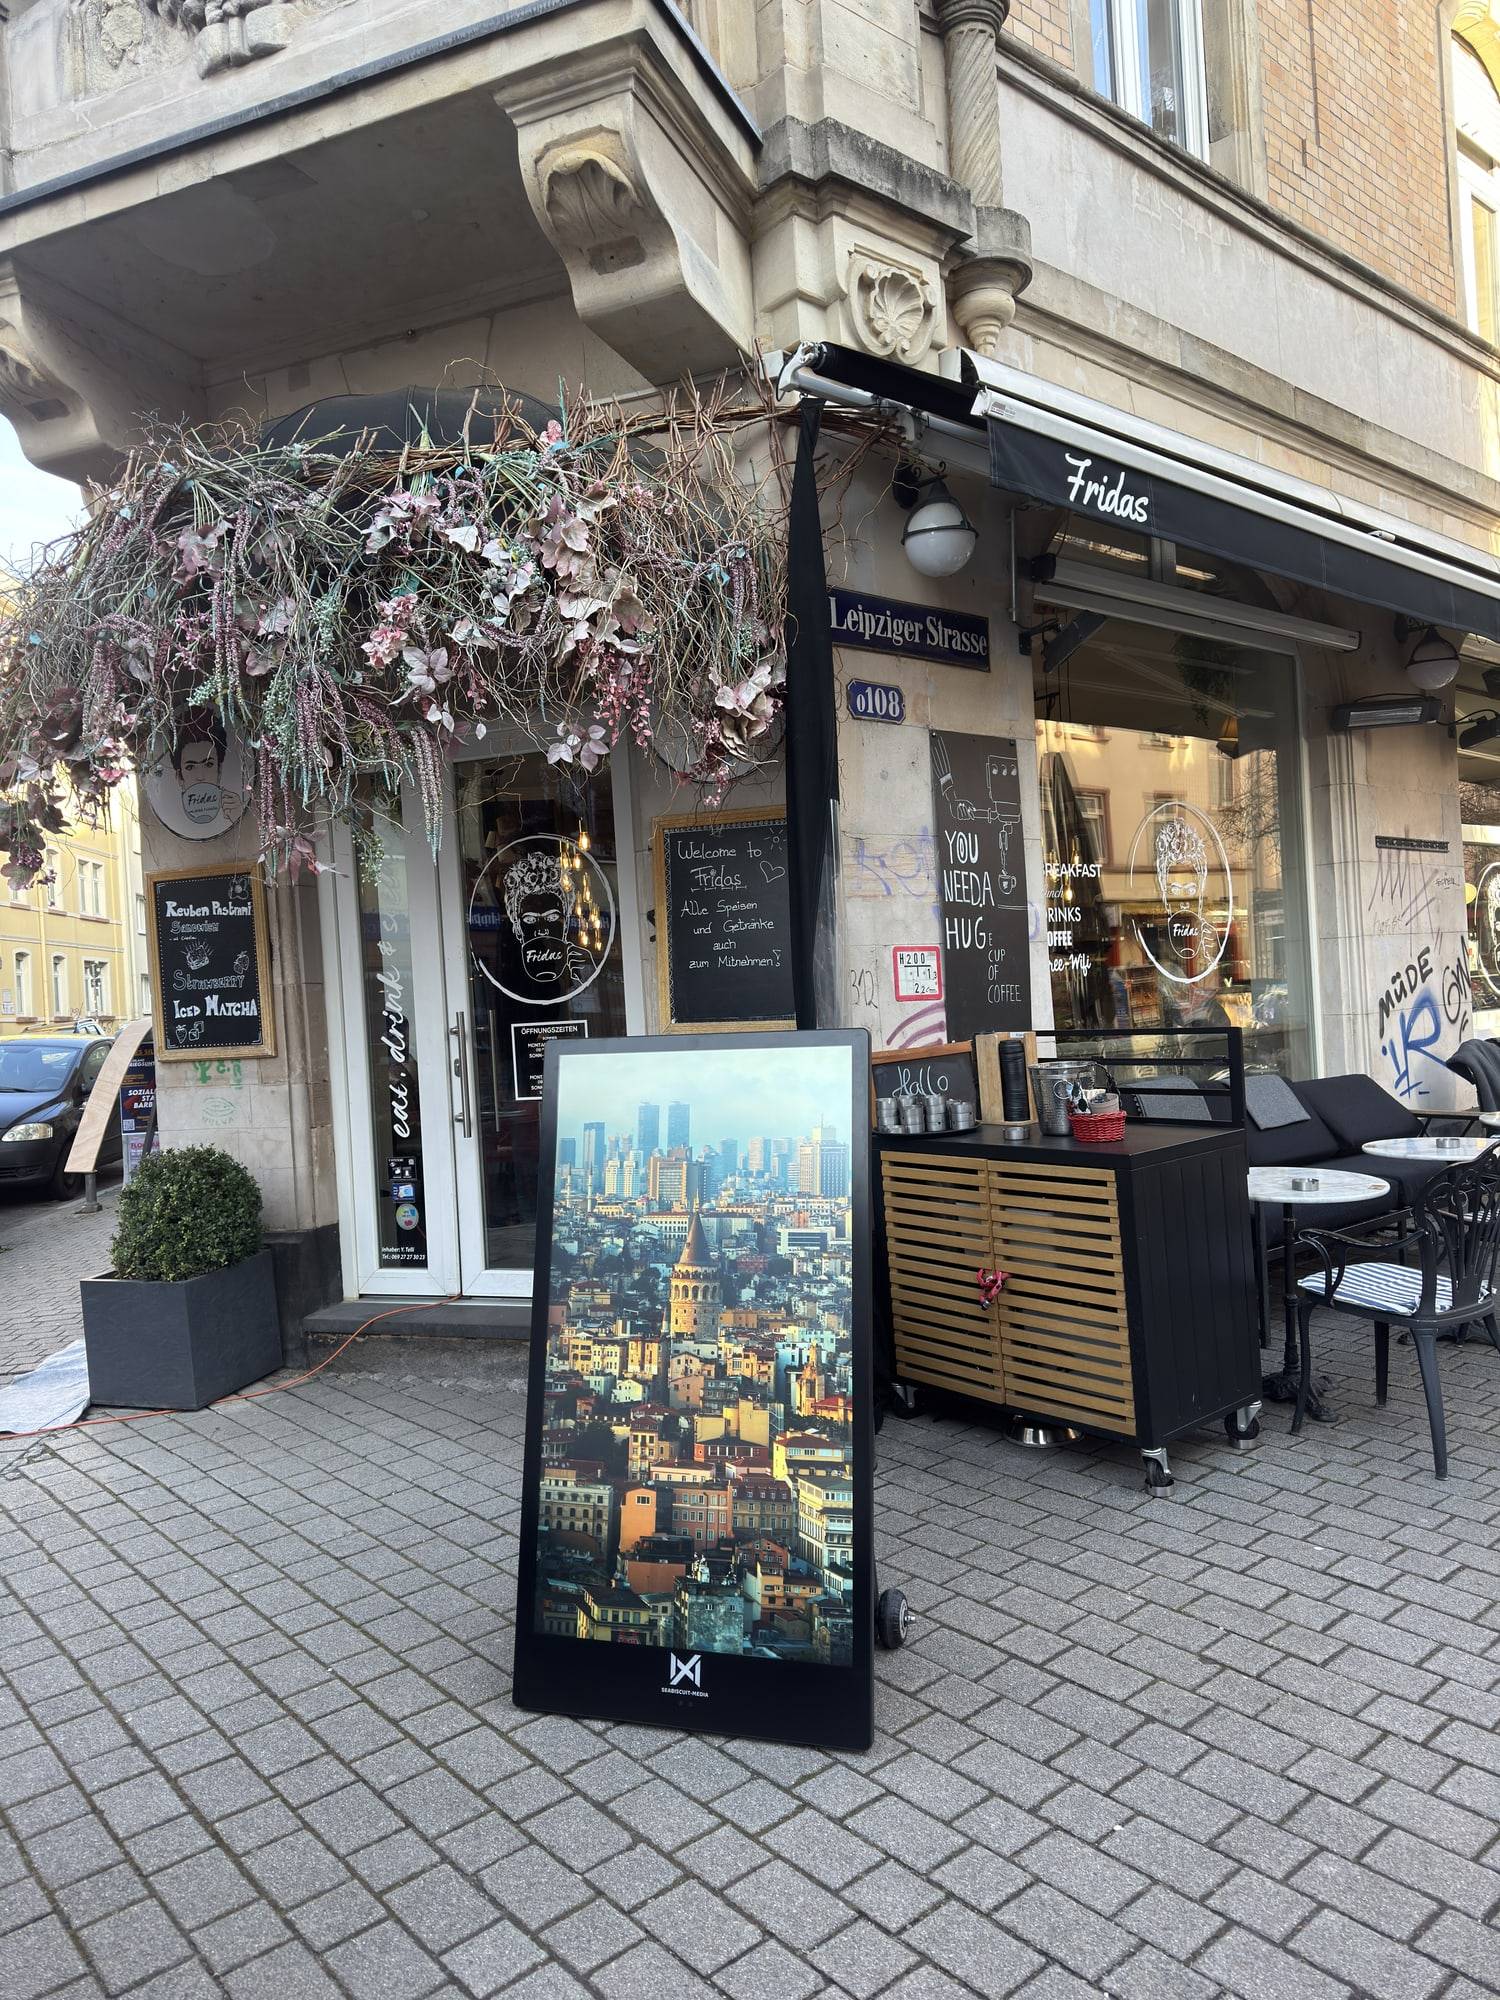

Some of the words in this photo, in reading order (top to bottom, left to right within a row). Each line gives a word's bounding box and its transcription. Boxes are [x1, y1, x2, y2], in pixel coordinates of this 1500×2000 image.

[1065, 453, 1149, 523] Fridas
[828, 597, 923, 646] Leipziger
[926, 616, 988, 656] Strasse
[677, 841, 737, 859] Welcome
[746, 842, 762, 858] to
[945, 830, 979, 864] YOU
[690, 865, 742, 887] Fridas
[1045, 863, 1103, 878] REAKFAST
[680, 900, 709, 917] Alle
[716, 899, 758, 917] Speisen
[1047, 906, 1082, 923] RINKS
[693, 922, 713, 934] und
[713, 940, 736, 950] auch
[1047, 930, 1073, 947] OFFEE
[526, 949, 563, 964] Fridas
[988, 949, 1006, 962] CUP
[689, 960, 710, 969] zum
[988, 965, 999, 981] OF
[1048, 953, 1092, 977] ree-Wifi
[987, 984, 1023, 1004] COFFEE
[521, 1025, 578, 1035] ÖFFNUNGSZEITEN
[892, 1065, 949, 1097] Hallo
